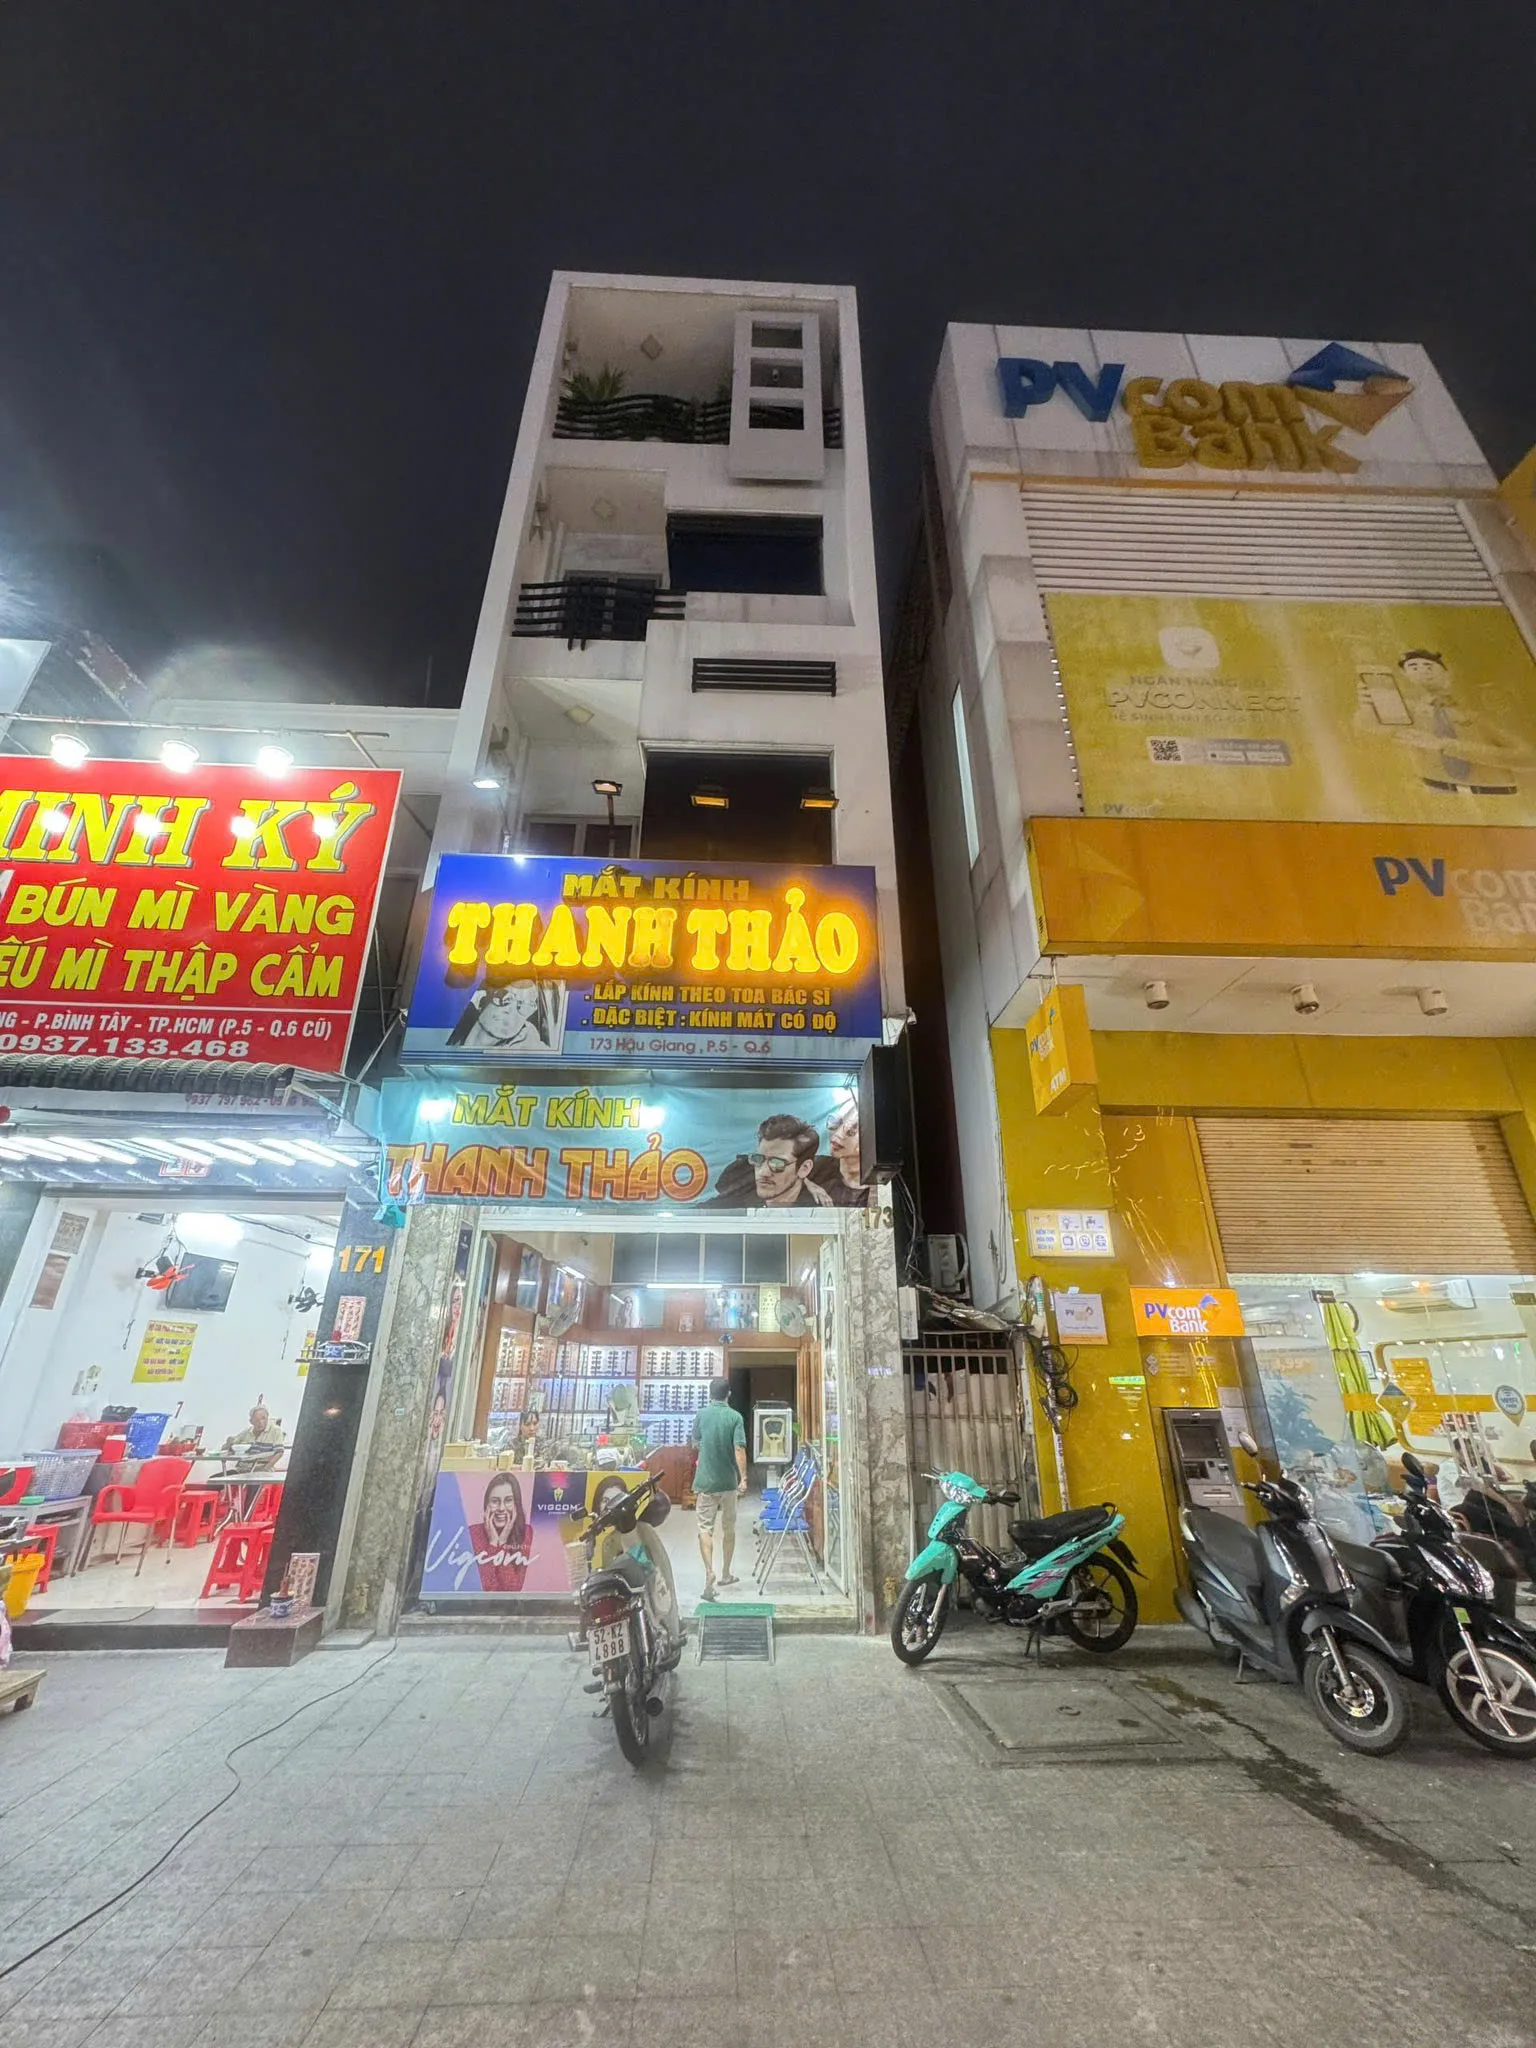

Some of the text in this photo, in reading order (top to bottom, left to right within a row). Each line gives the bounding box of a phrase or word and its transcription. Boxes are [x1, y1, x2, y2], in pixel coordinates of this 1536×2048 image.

[995, 357, 1305, 426] PVcom
[1132, 414, 1362, 474] Bank
[221, 781, 377, 872] KÝ
[562, 864, 750, 902] MẮT KÍNH
[6, 877, 356, 936] BÚN MÌ VÀNG
[447, 886, 860, 974] THANH THẢO
[50, 938, 113, 991] MÌ
[123, 941, 239, 1001] THẬP
[250, 942, 344, 998] CẨM
[630, 981, 675, 1002] KÍNH
[679, 986, 726, 1004] THEO
[731, 987, 766, 1005] TOA
[771, 984, 808, 1006] BÁC
[812, 984, 832, 1006] SĨ
[33, 1010, 95, 1031] P.BÌNH
[100, 1010, 133, 1032] TÂY
[148, 1015, 214, 1035] TP.HCM
[218, 1016, 252, 1037] (P.5
[270, 1019, 298, 1037] Q.6
[302, 1017, 333, 1041] CŨ)
[592, 1005, 631, 1029] ĐẶC
[636, 1006, 678, 1031] BIỆT
[689, 1007, 733, 1029] KÍNH
[736, 1008, 776, 1030] MÁT
[780, 1009, 806, 1030] CÓ
[811, 1009, 838, 1034] ĐỘ
[0, 1033, 250, 1057] 0937.133.468
[590, 1036, 612, 1050] 173
[616, 1037, 645, 1053] Hậu
[650, 1039, 696, 1055] Giang
[706, 1040, 728, 1053] P.5
[744, 1040, 771, 1054] Q.6
[453, 1085, 642, 1130] MẮT KÍNH
[386, 1133, 710, 1200] THANH THẢO
[861, 1205, 894, 1230] 173
[339, 1244, 386, 1274] 171
[1144, 1302, 1200, 1320] PVcom
[1168, 1319, 1209, 1334] Bank
[537, 1503, 578, 1511] VIGCOM
[424, 1525, 540, 1591] Vigcom
